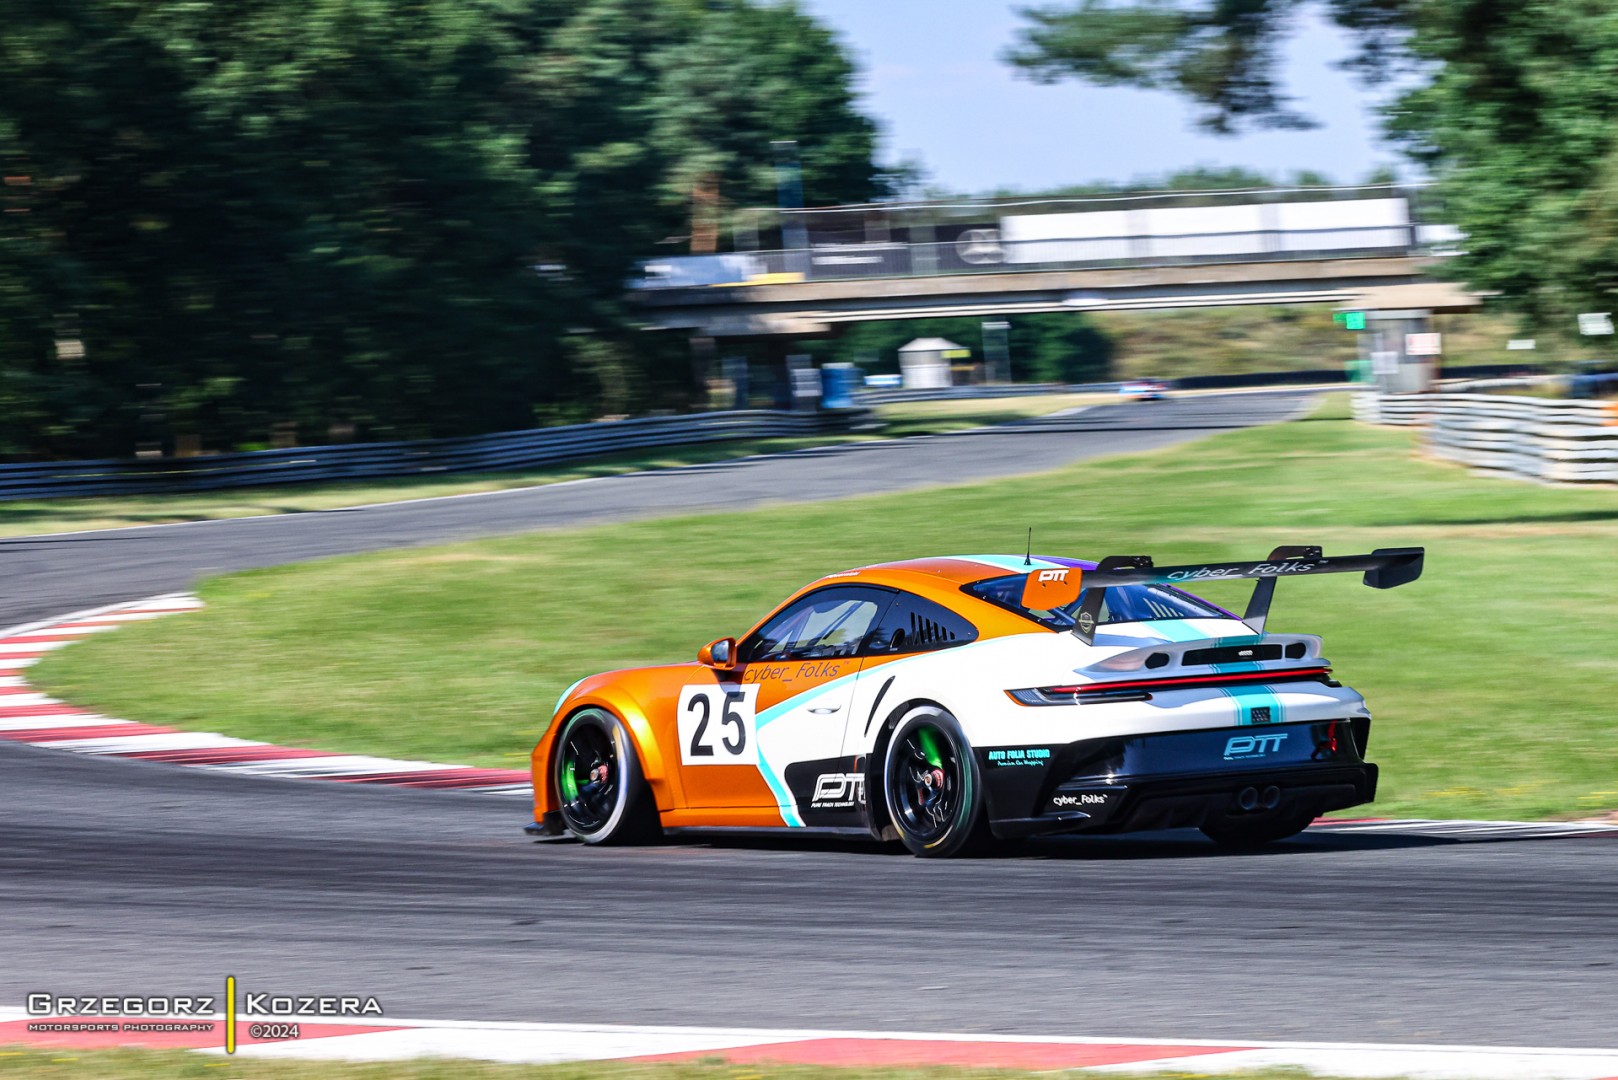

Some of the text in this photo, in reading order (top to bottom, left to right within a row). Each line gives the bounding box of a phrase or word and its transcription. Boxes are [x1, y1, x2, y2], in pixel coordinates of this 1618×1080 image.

[1038, 569, 1070, 582] PTT
[687, 691, 746, 756] 25
[1223, 733, 1288, 756] PTT
[988, 748, 1050, 760] AUTO FOLIA STUDIO
